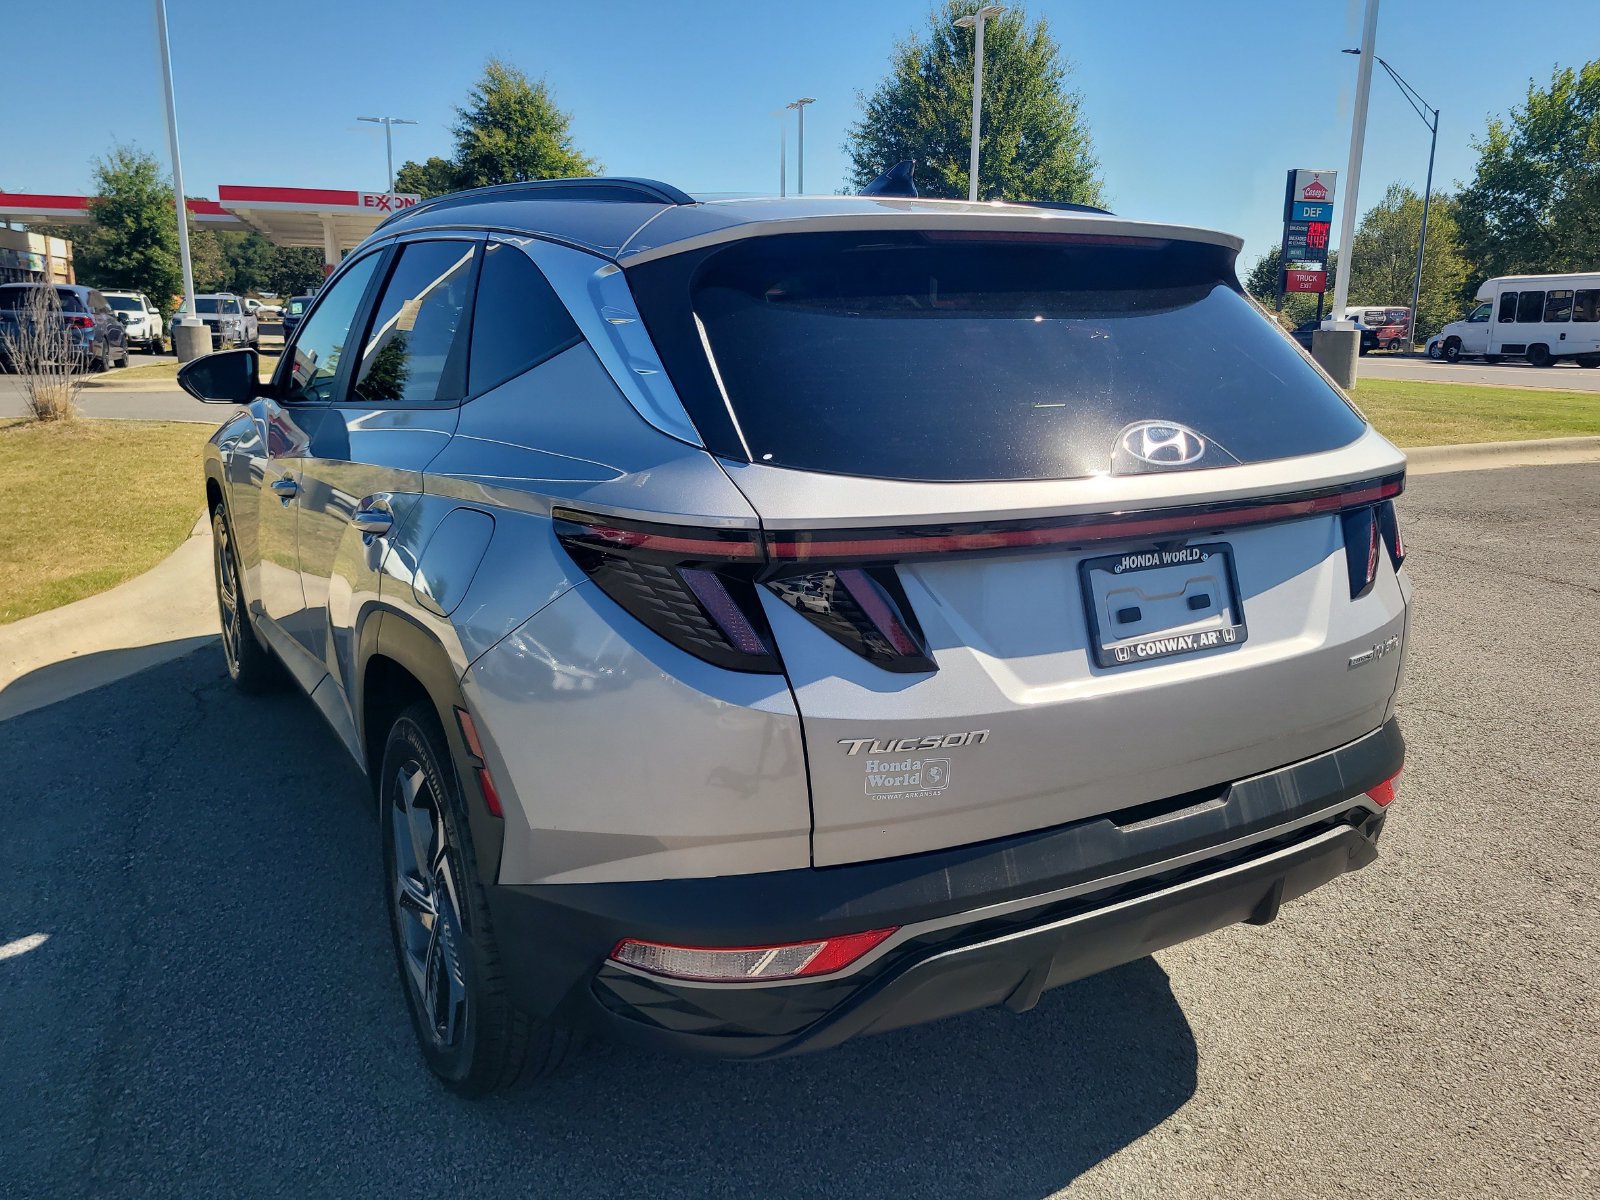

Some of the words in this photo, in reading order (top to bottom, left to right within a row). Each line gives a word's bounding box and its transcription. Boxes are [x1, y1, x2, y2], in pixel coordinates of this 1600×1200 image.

[364, 195, 416, 212] EXXON
[1303, 207, 1323, 217] DEF
[1296, 274, 1317, 282] TRUCK
[1121, 553, 1160, 570] HONDA
[1162, 548, 1200, 564] WORLD
[1136, 634, 1198, 657] CONWAY,
[1200, 632, 1218, 646] AR
[865, 759, 922, 773] Honda
[867, 772, 921, 788] World
[871, 793, 904, 801] CONWAY,
[904, 790, 942, 799] ARKANSAS
